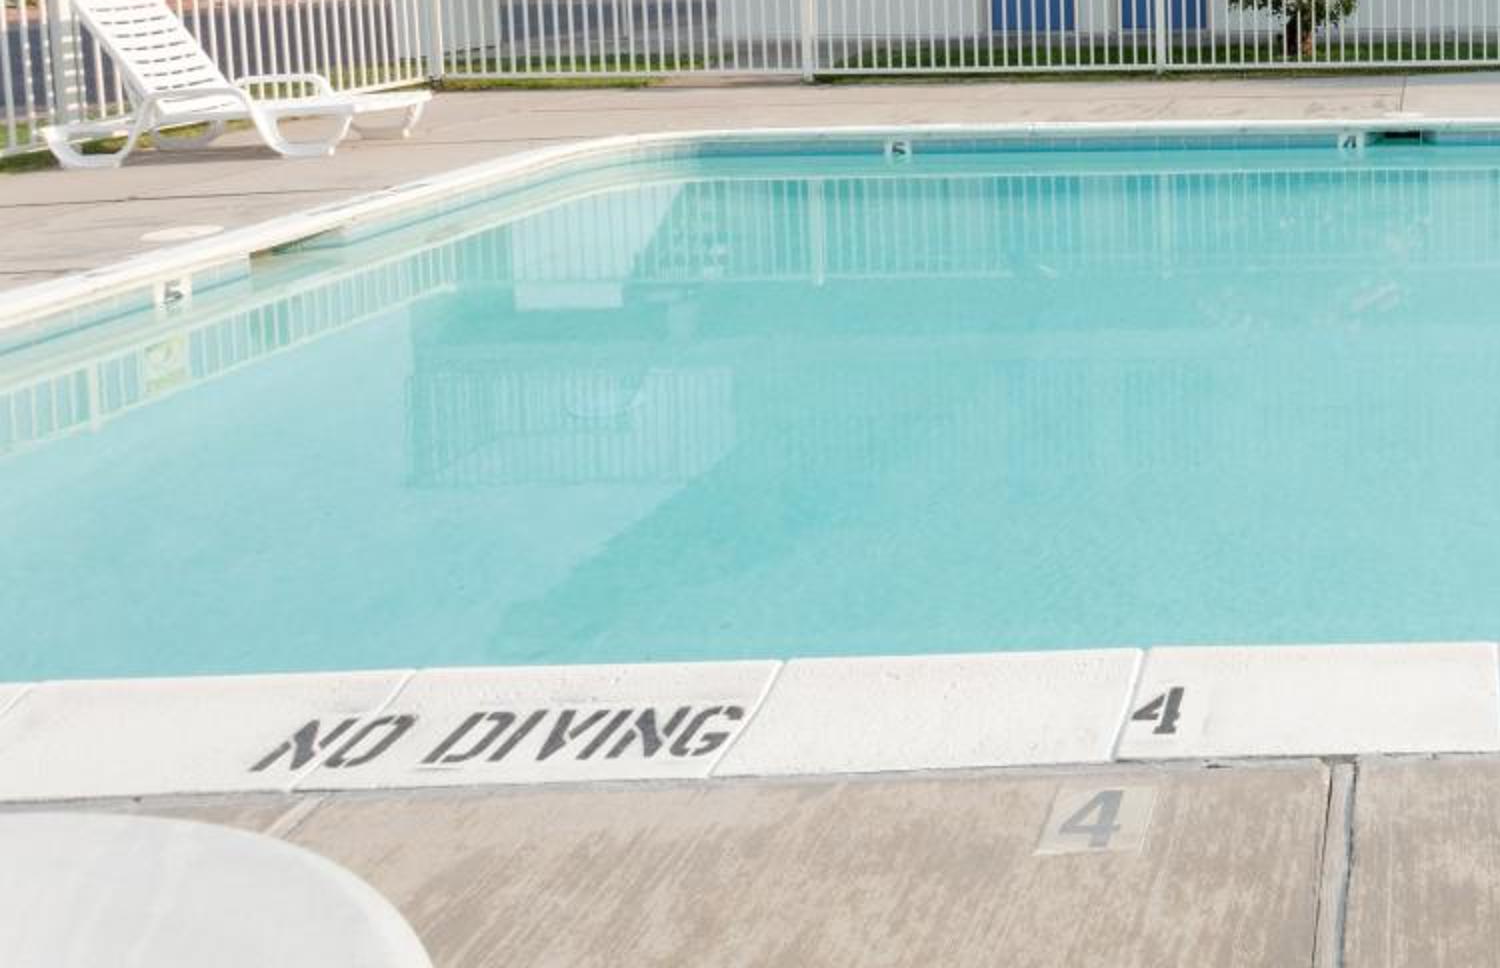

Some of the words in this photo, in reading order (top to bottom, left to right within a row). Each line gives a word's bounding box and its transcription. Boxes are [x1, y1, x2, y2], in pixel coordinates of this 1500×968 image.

[163, 280, 184, 304] 5
[1131, 686, 1185, 734] 4
[250, 714, 418, 771] NO
[420, 706, 745, 764] DIVING
[1057, 789, 1124, 848] 4
